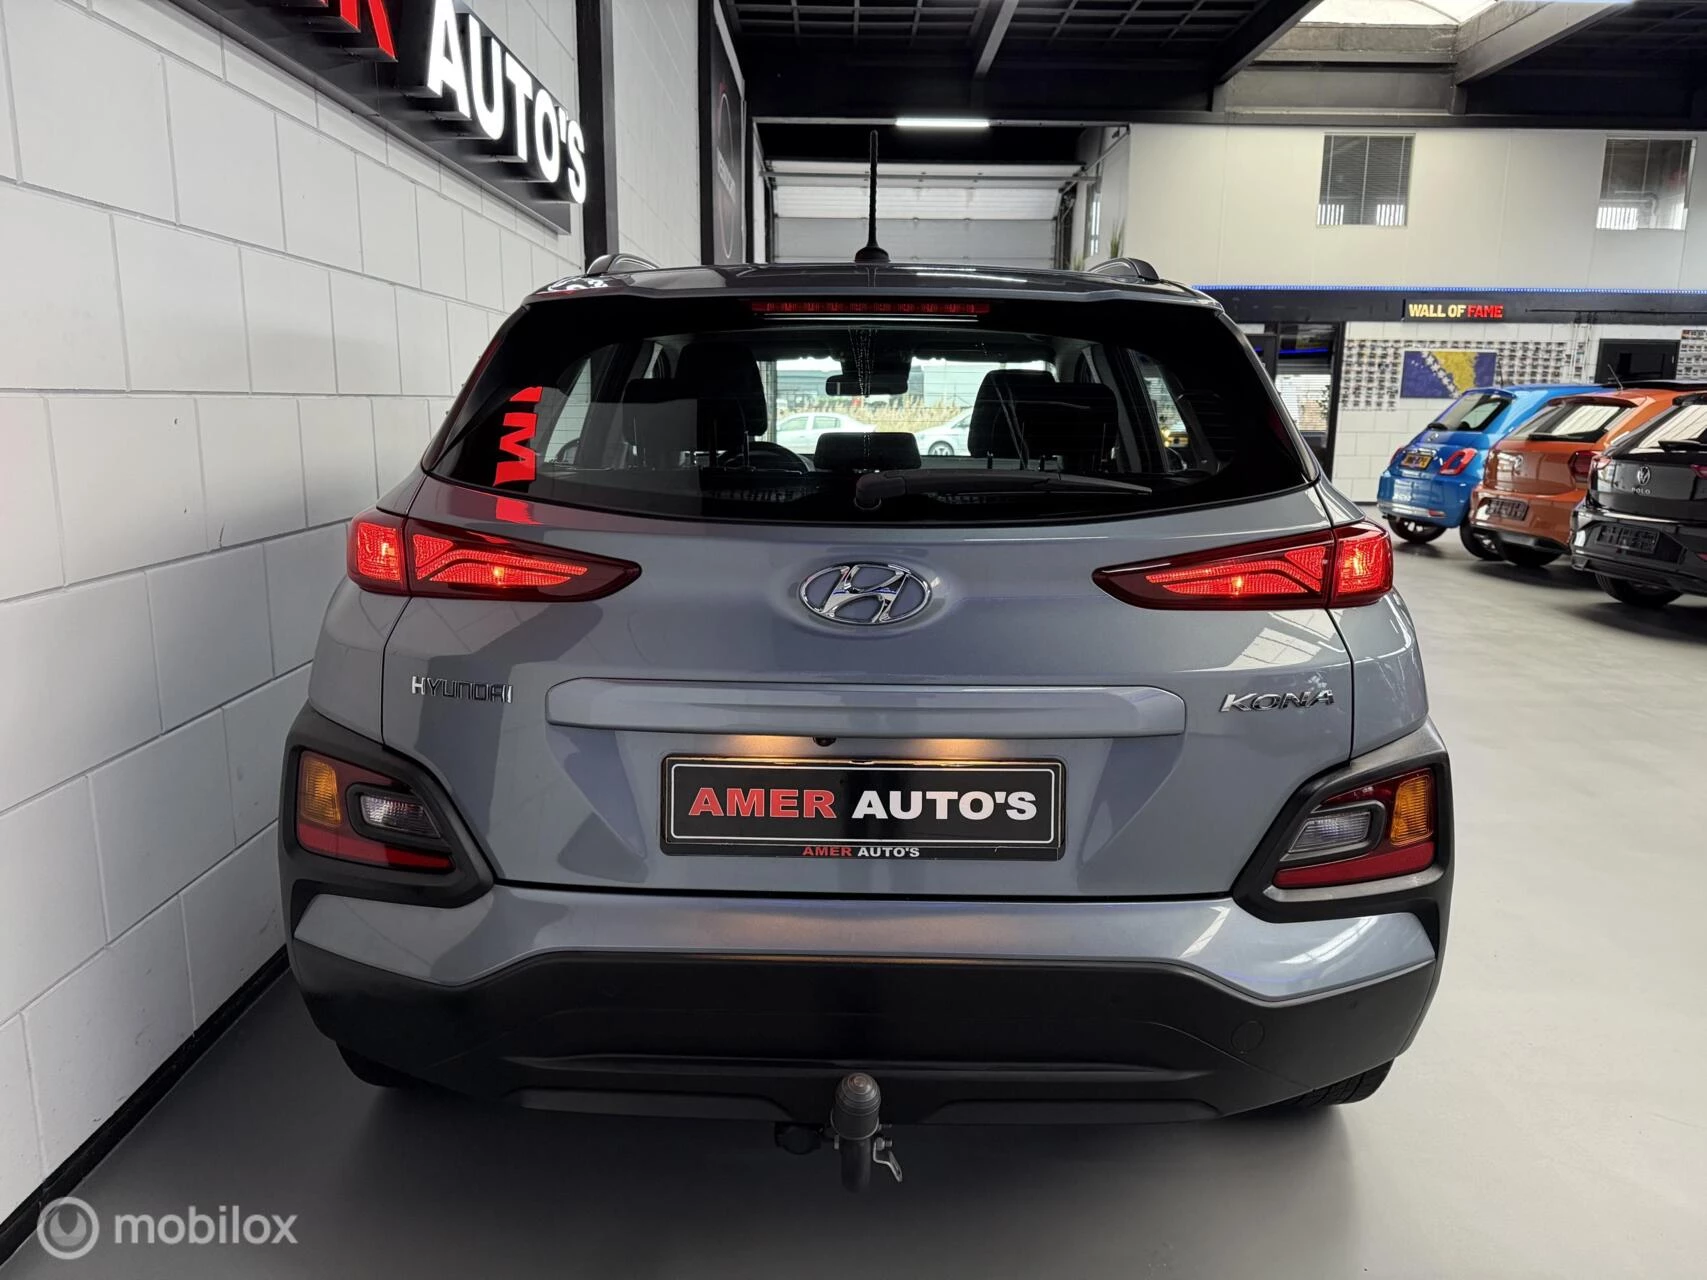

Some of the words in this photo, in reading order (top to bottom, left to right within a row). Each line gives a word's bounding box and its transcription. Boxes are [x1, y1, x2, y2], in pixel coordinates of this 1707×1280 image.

[427, 0, 587, 204] AUTO'S
[1408, 303, 1446, 318] WALL
[1447, 304, 1467, 318] OF
[1467, 303, 1504, 318] FAME
[411, 676, 513, 704] HYUNDAI
[1219, 689, 1335, 713] KONA
[688, 787, 837, 819] AMER
[852, 790, 1038, 821] AUTO'S
[802, 846, 852, 857] AMER
[858, 846, 920, 858] AUTO'S
